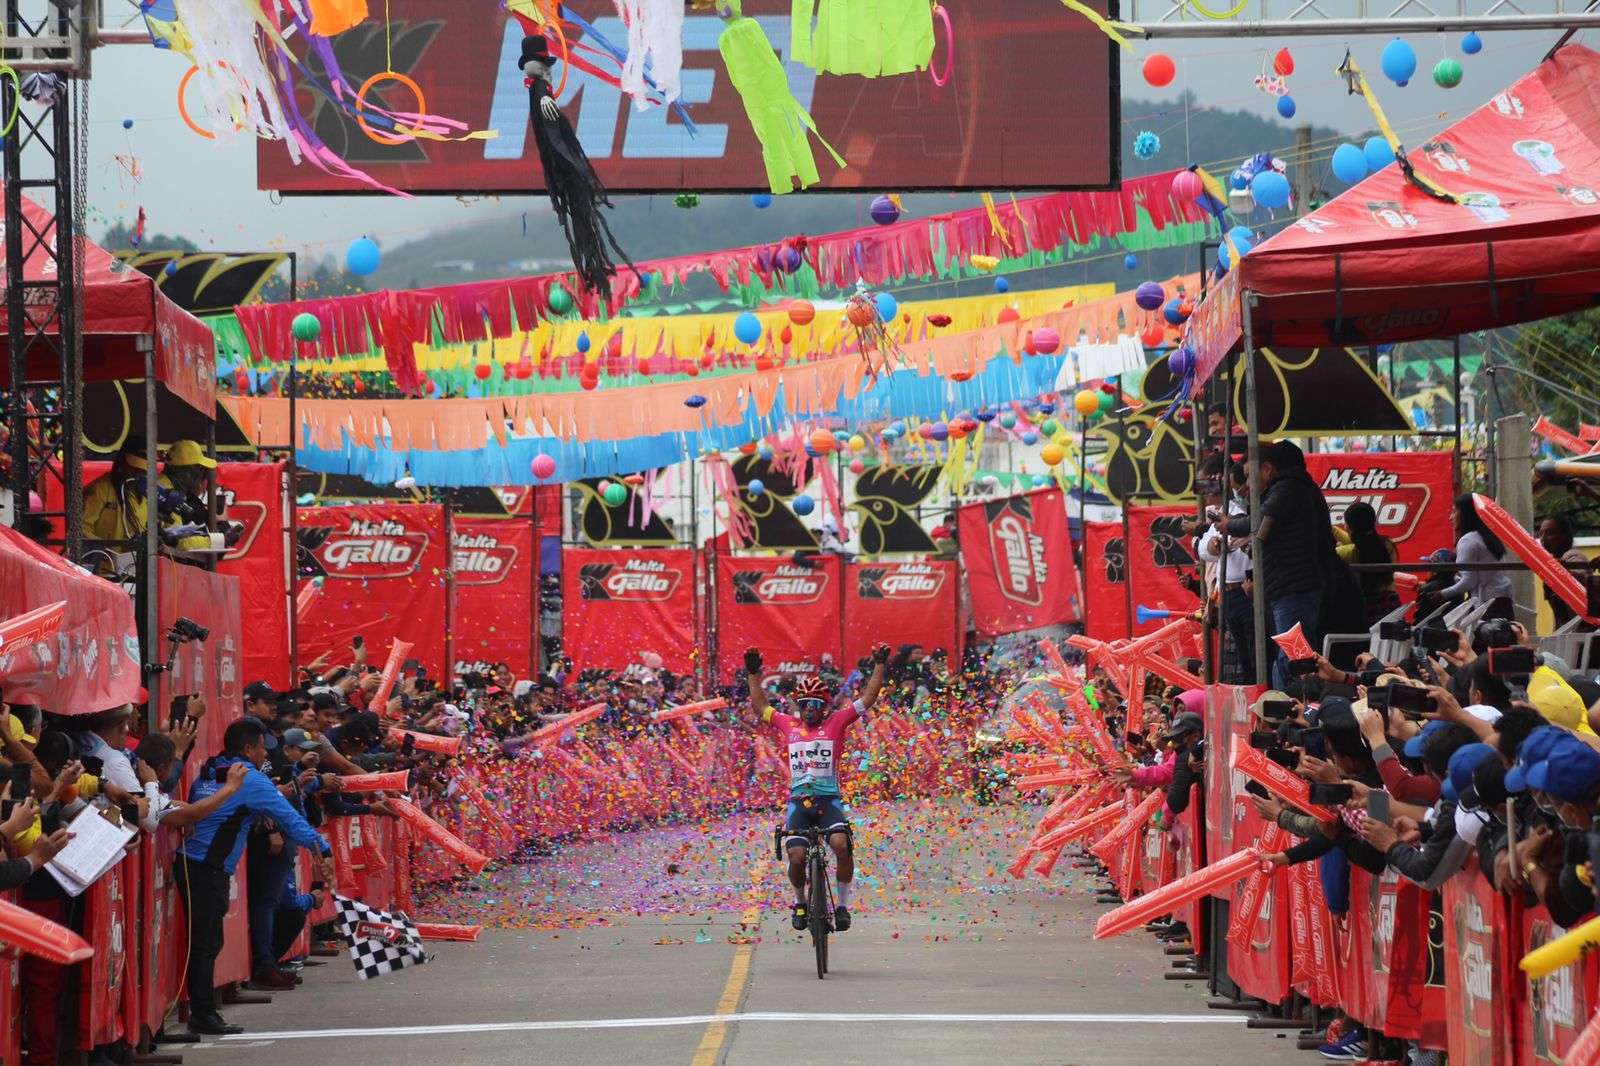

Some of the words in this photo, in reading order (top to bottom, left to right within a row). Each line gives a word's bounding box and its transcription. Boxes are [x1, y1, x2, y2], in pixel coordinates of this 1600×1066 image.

[1321, 468, 1398, 490] Malta
[348, 519, 405, 537] Malta
[324, 540, 412, 569] Gallo
[455, 550, 502, 573] allo
[996, 516, 1028, 592] Gallo
[1028, 533, 1047, 583] Malta
[624, 559, 665, 572] Malta
[774, 565, 812, 576] Malta
[896, 563, 932, 574] Malta
[607, 573, 669, 595] Gallo
[759, 578, 817, 599] Gallo
[881, 575, 935, 594] Gallo
[776, 661, 815, 672] Malta
